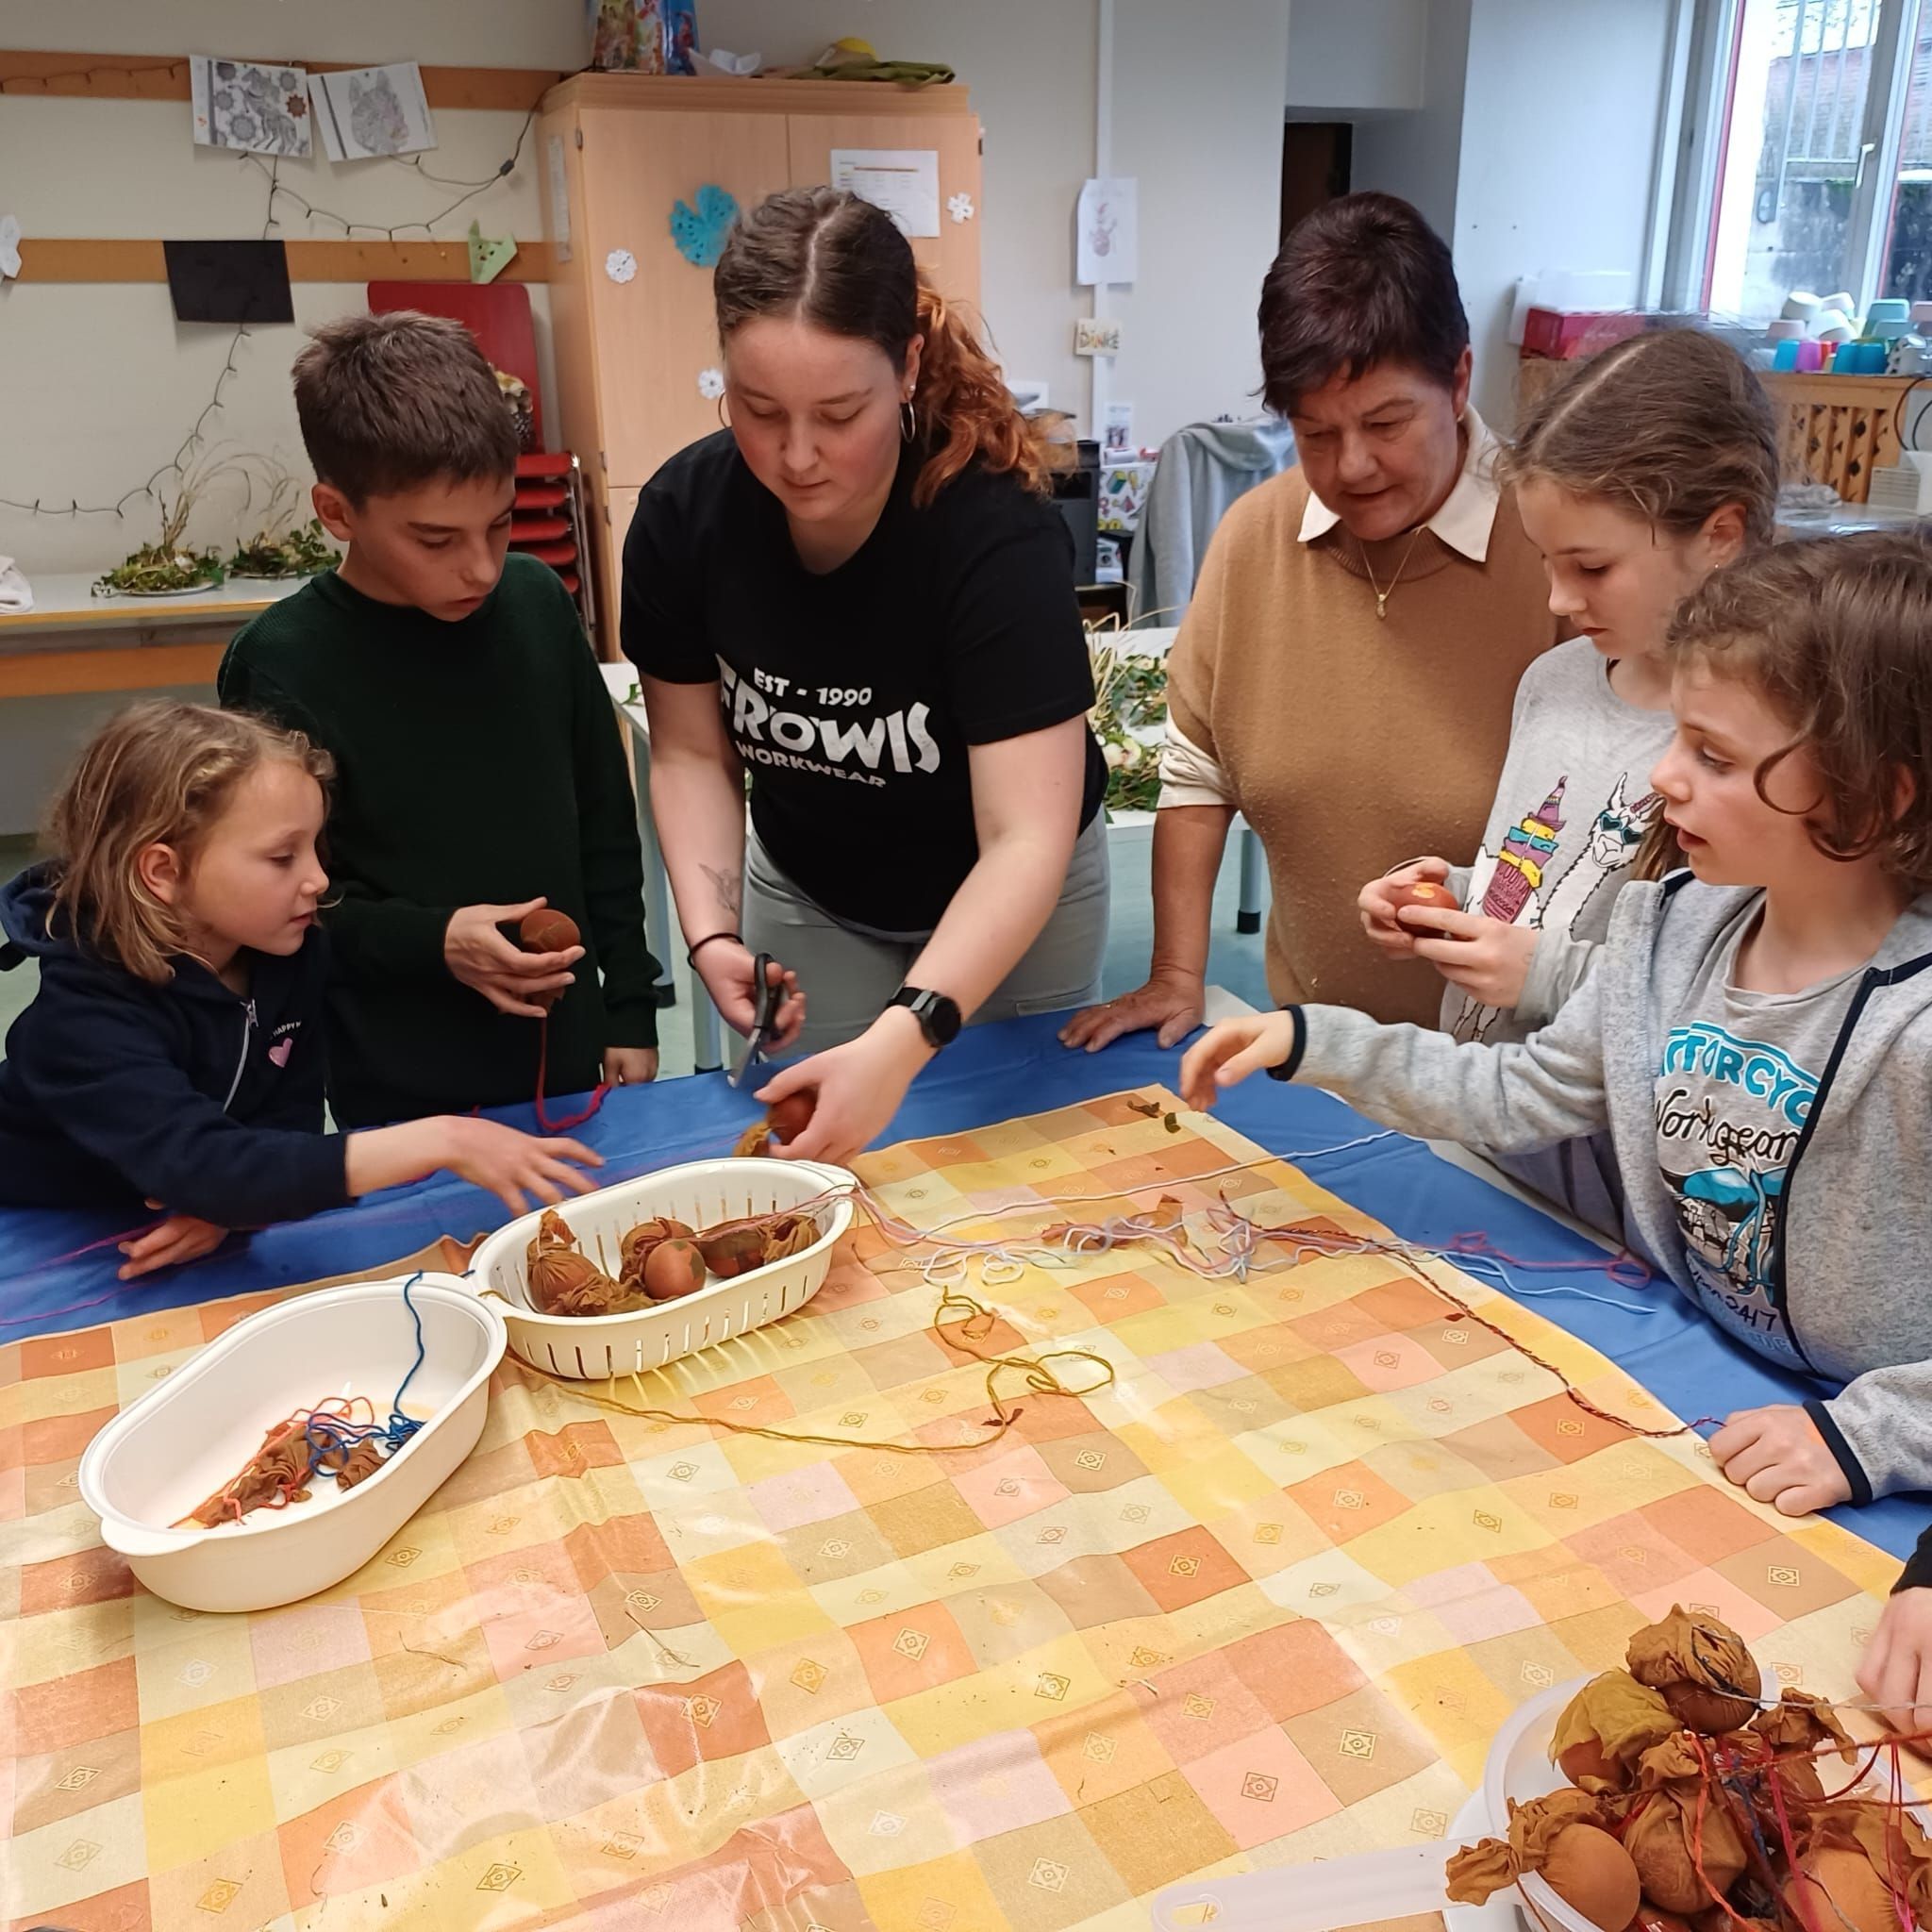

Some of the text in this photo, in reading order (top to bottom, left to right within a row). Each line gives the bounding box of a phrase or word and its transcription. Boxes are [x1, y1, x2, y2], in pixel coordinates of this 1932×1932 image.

[754, 668, 791, 697] EST
[816, 687, 873, 707] 1990
[735, 740, 887, 788] WORKWEAR
